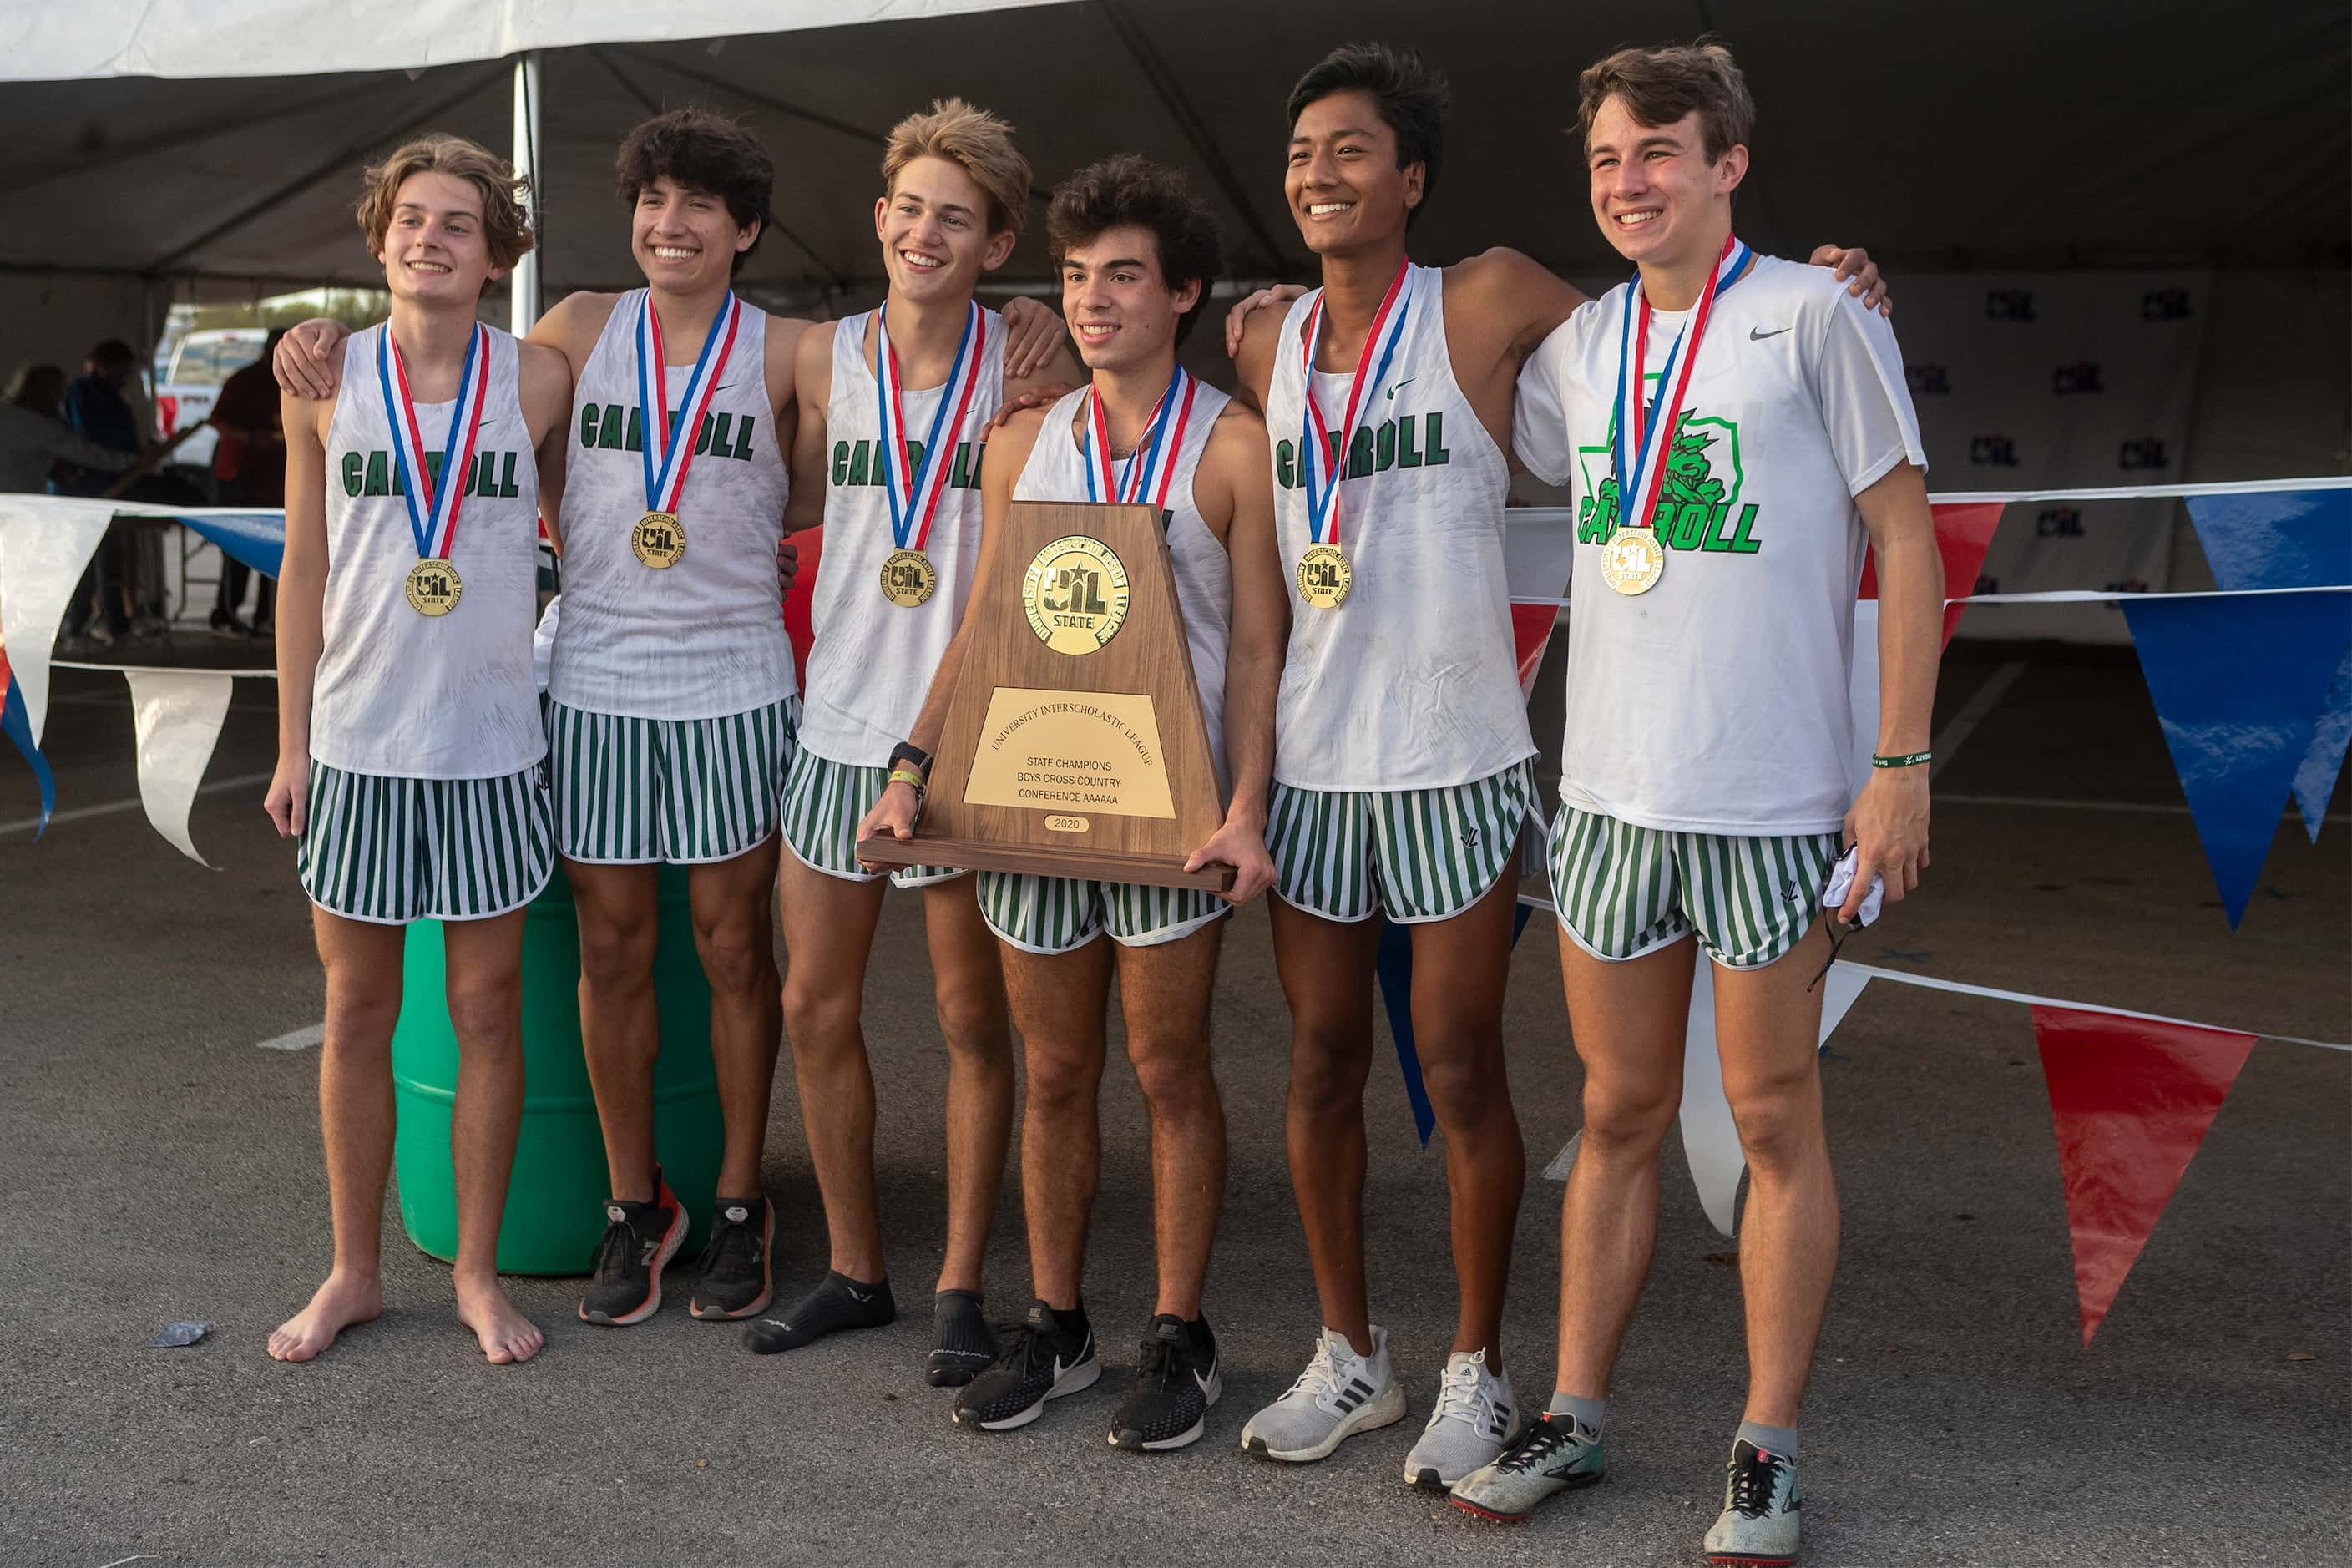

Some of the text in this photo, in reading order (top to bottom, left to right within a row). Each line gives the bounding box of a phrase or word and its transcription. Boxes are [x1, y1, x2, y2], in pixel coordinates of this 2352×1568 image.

[1276, 412, 1450, 490] CROLL
[1577, 496, 1763, 554] CAROLL
[642, 526, 675, 551] UIL
[646, 549, 668, 558] STATE
[1613, 541, 1651, 572] UIL
[417, 572, 451, 596] UIL
[891, 563, 924, 589] UIL
[1307, 559, 1340, 588] UIL
[1619, 572, 1644, 582] STATE
[1044, 560, 1107, 615] UIL
[1052, 615, 1095, 629] STATE
[991, 703, 1153, 767] UNIVERSITY INTERSCHOLASTIC LEAGUE
[1027, 756, 1112, 771] STATE CHAMPIONS
[1017, 771, 1122, 788] BOYS CROSS COUNTRY
[1019, 788, 1118, 804] CONFERENCE AAAAAA
[1055, 818, 1080, 829] 2020
